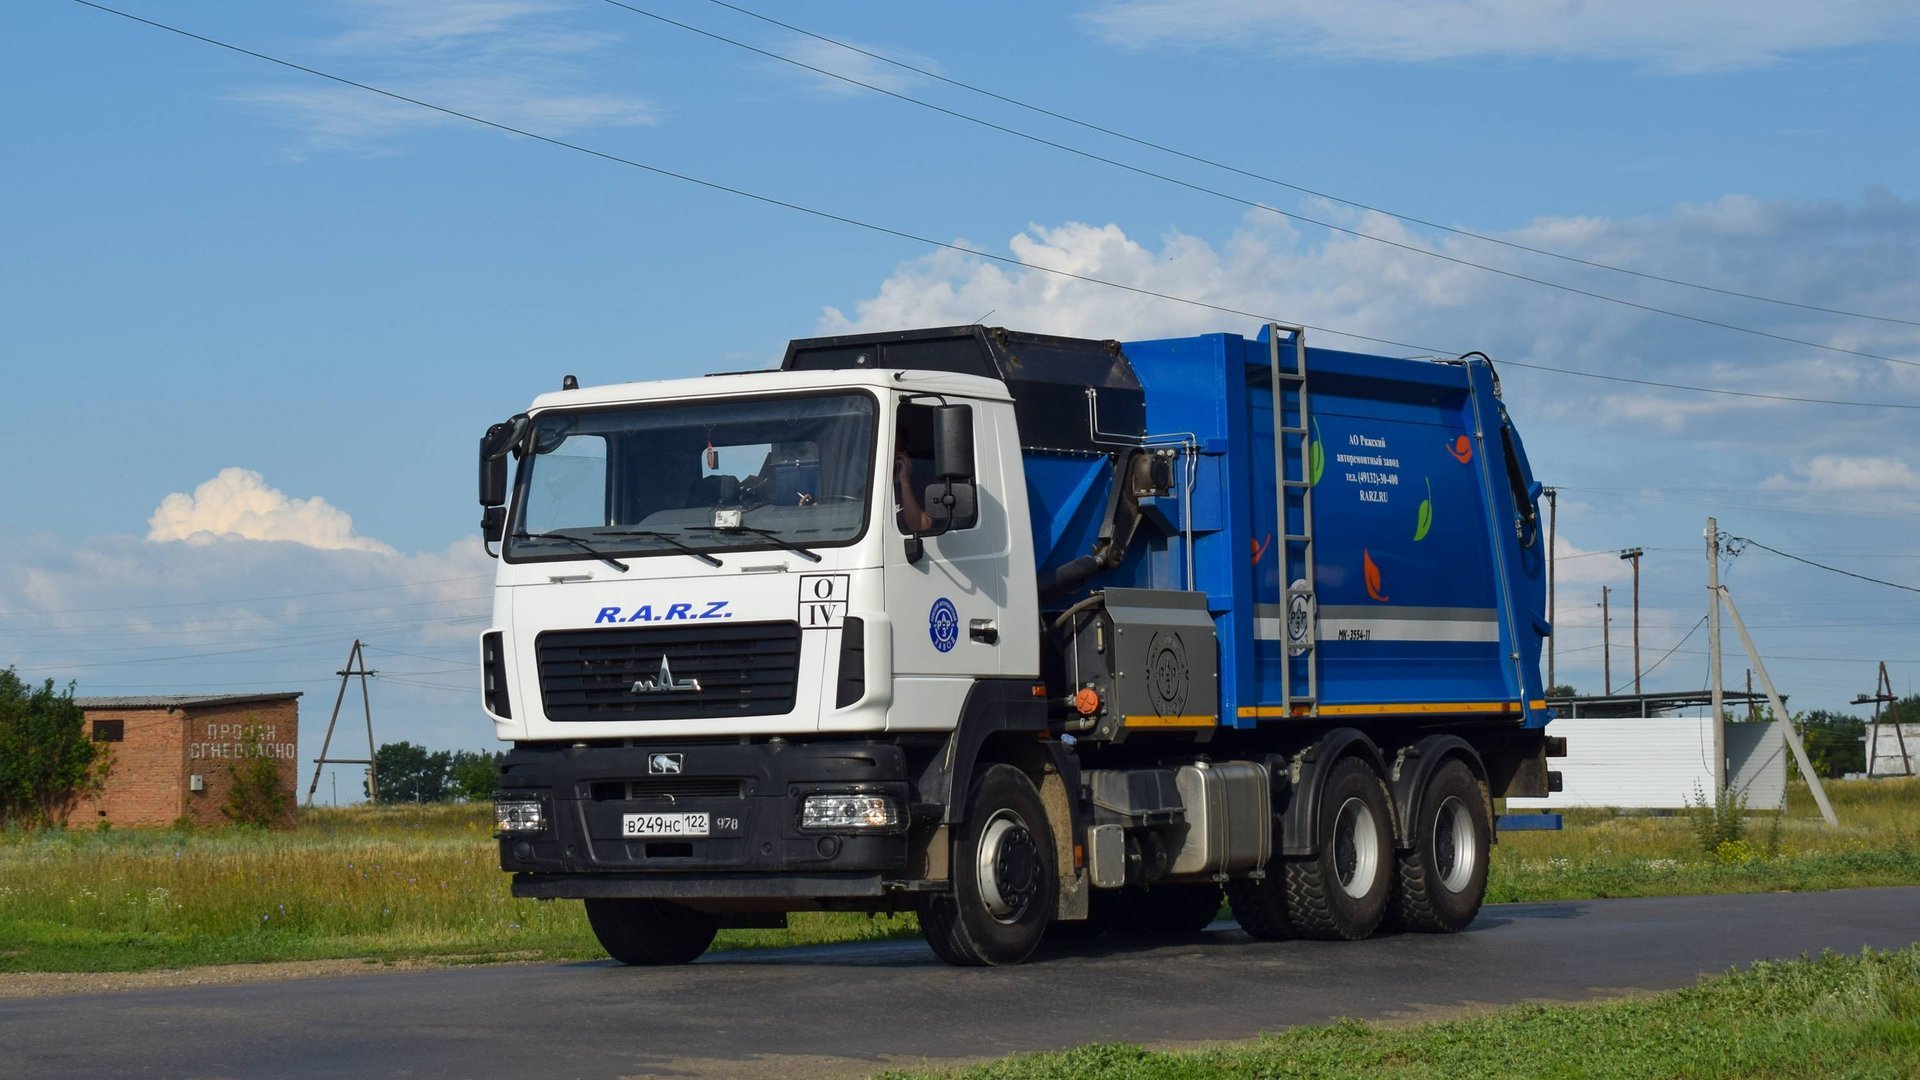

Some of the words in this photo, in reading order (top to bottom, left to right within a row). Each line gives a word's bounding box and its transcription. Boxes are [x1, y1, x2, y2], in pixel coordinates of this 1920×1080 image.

[1349, 434, 1359, 446] АО
[1360, 490, 1388, 503] RARZ.RU
[594, 601, 733, 624] R.A.R.Z.
[810, 604, 837, 626] IV
[685, 815, 705, 827] 122
[717, 818, 738, 830] 978
